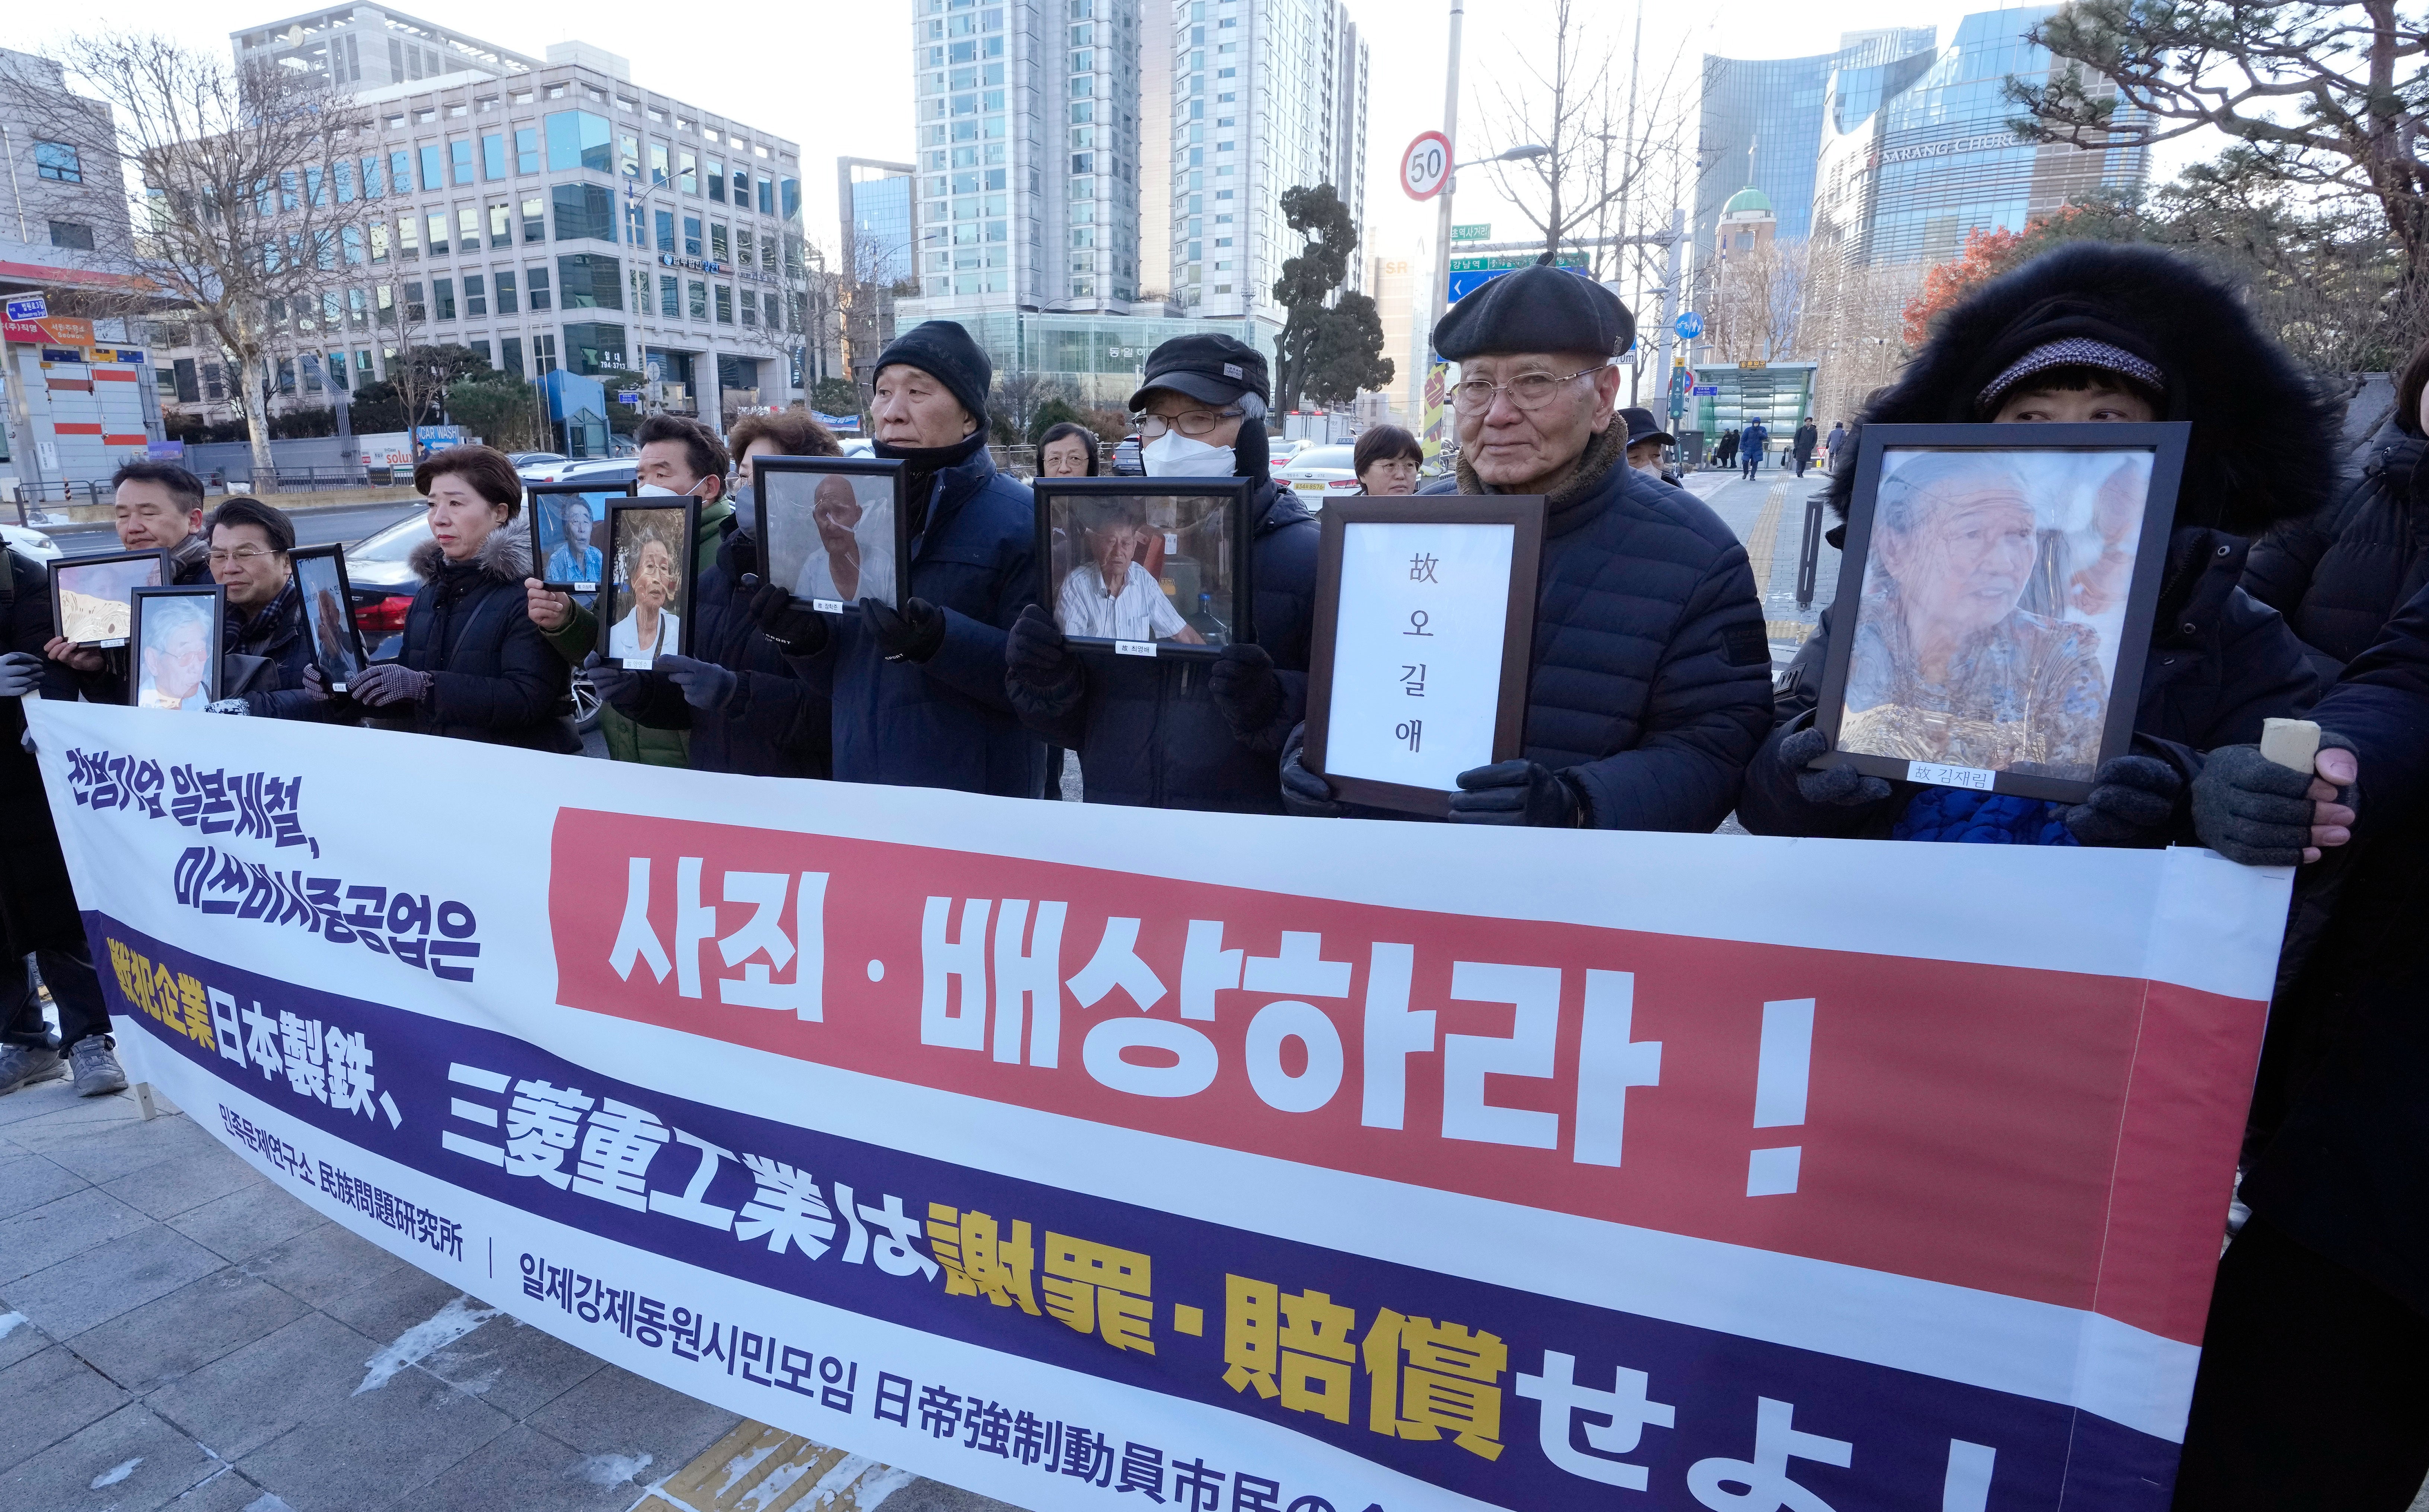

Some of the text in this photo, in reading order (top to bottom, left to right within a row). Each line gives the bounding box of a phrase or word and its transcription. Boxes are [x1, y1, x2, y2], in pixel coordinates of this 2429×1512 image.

[1882, 132, 2036, 163] SARANG CHURC
[1411, 149, 1441, 182] 50
[1451, 226, 1488, 238] 초역사거리
[673, 256, 702, 270] 법무법인
[1453, 260, 1480, 269] 강남역
[51, 323, 85, 333] 서원주유소
[421, 426, 458, 439] CAR WASH
[1132, 645, 1149, 653] 최영배
[1396, 553, 1439, 753] 故 오길애
[1915, 766, 1987, 789] 故 김재림
[174, 845, 481, 982] 미쓰비시중공업은
[608, 857, 829, 1023] 사죄
[921, 895, 1663, 1169] 배상하라
[219, 1103, 315, 1187] 민족문제연구소
[520, 1253, 858, 1415] 일제강제동원시민모임
